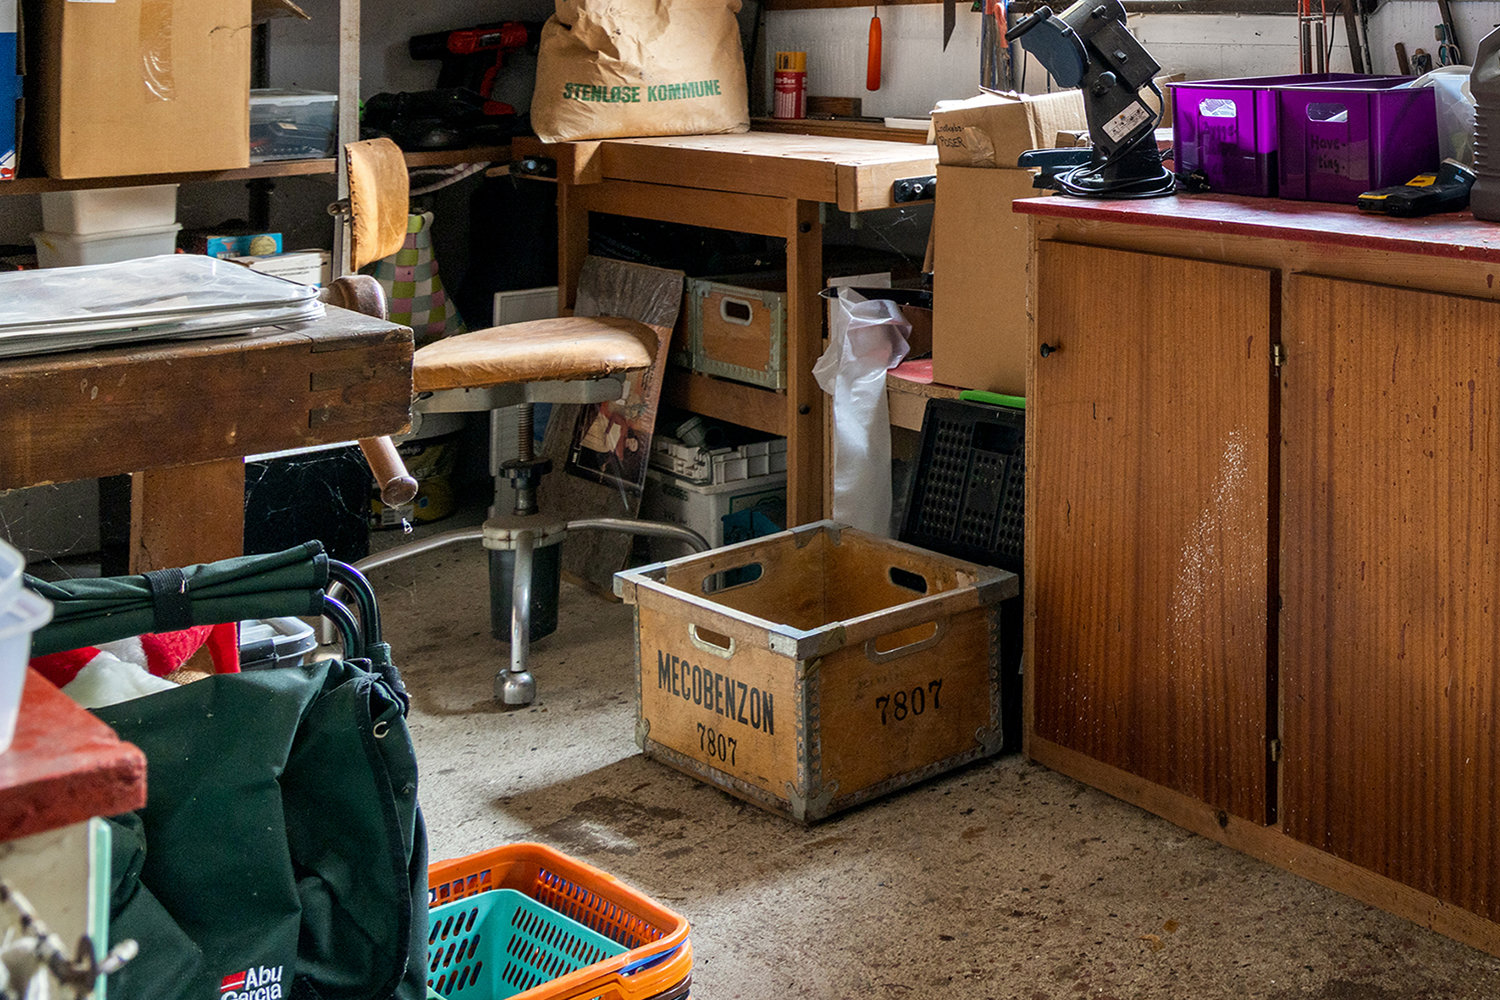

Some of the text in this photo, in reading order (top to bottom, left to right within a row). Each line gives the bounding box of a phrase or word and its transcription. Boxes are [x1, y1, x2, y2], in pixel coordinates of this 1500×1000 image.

[563, 79, 722, 103] STENLØSE KOMMUNE
[657, 649, 775, 736] MECOBENZON
[875, 679, 943, 726] 7807
[697, 724, 738, 767] 7807
[245, 966, 283, 991] Abu
